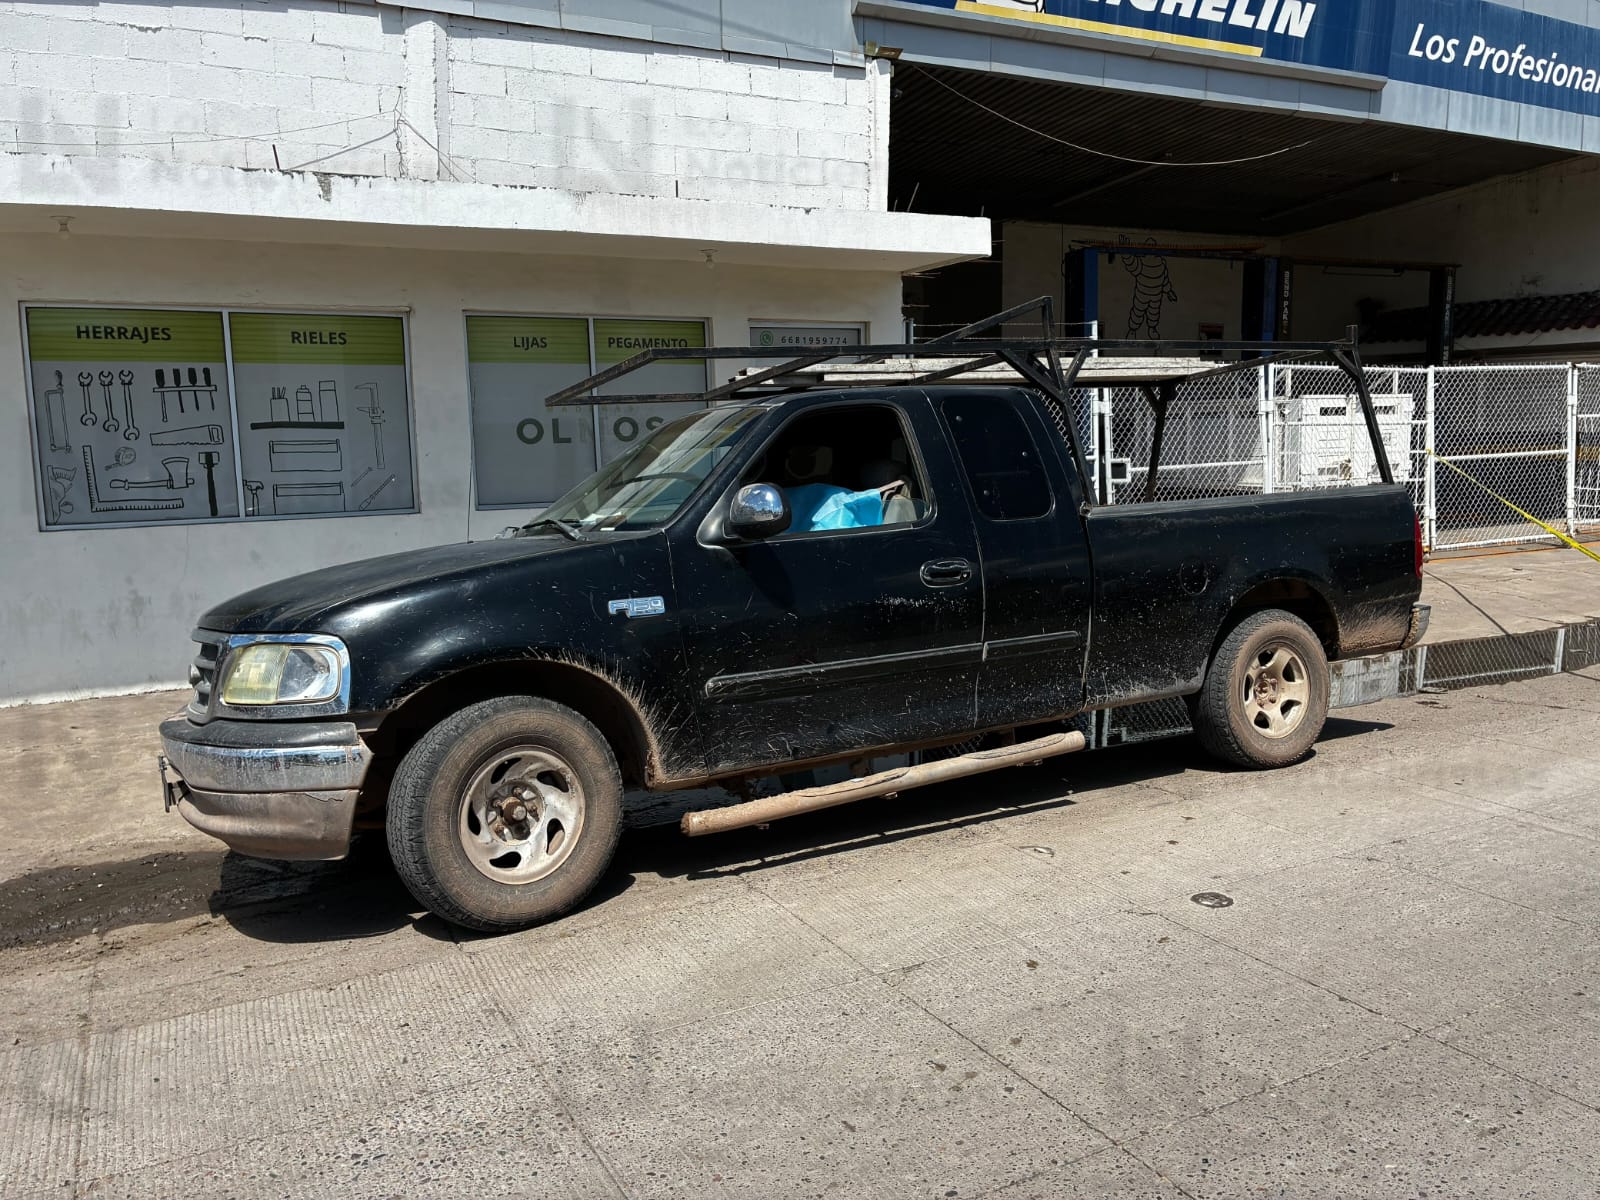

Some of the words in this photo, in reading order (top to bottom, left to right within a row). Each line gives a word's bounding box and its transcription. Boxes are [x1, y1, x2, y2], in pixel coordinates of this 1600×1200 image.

[1088, 0, 1316, 38] HELIN
[1408, 22, 1460, 64] Los
[76, 325, 172, 344] HERRAJES
[291, 331, 347, 345] RIELES
[607, 336, 688, 348] PEGAMENTO
[513, 336, 548, 351] LIJAS
